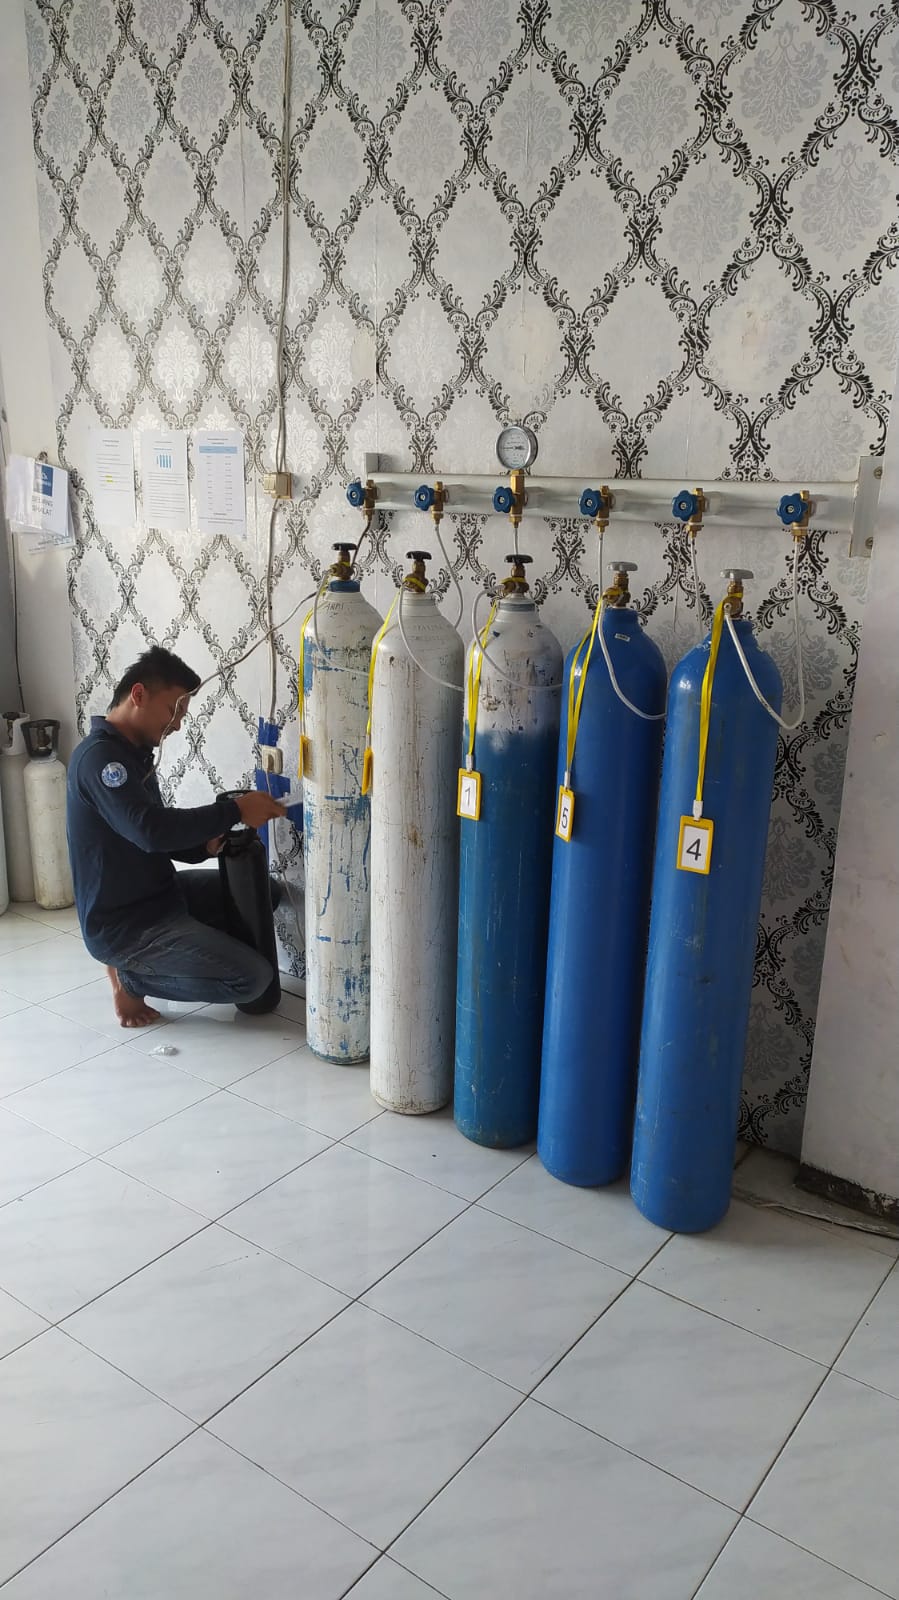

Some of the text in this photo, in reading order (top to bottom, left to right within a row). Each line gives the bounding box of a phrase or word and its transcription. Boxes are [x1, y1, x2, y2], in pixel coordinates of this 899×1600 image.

[465, 787, 471, 807] 1
[561, 808, 569, 829] 5
[686, 838, 702, 861] 4
